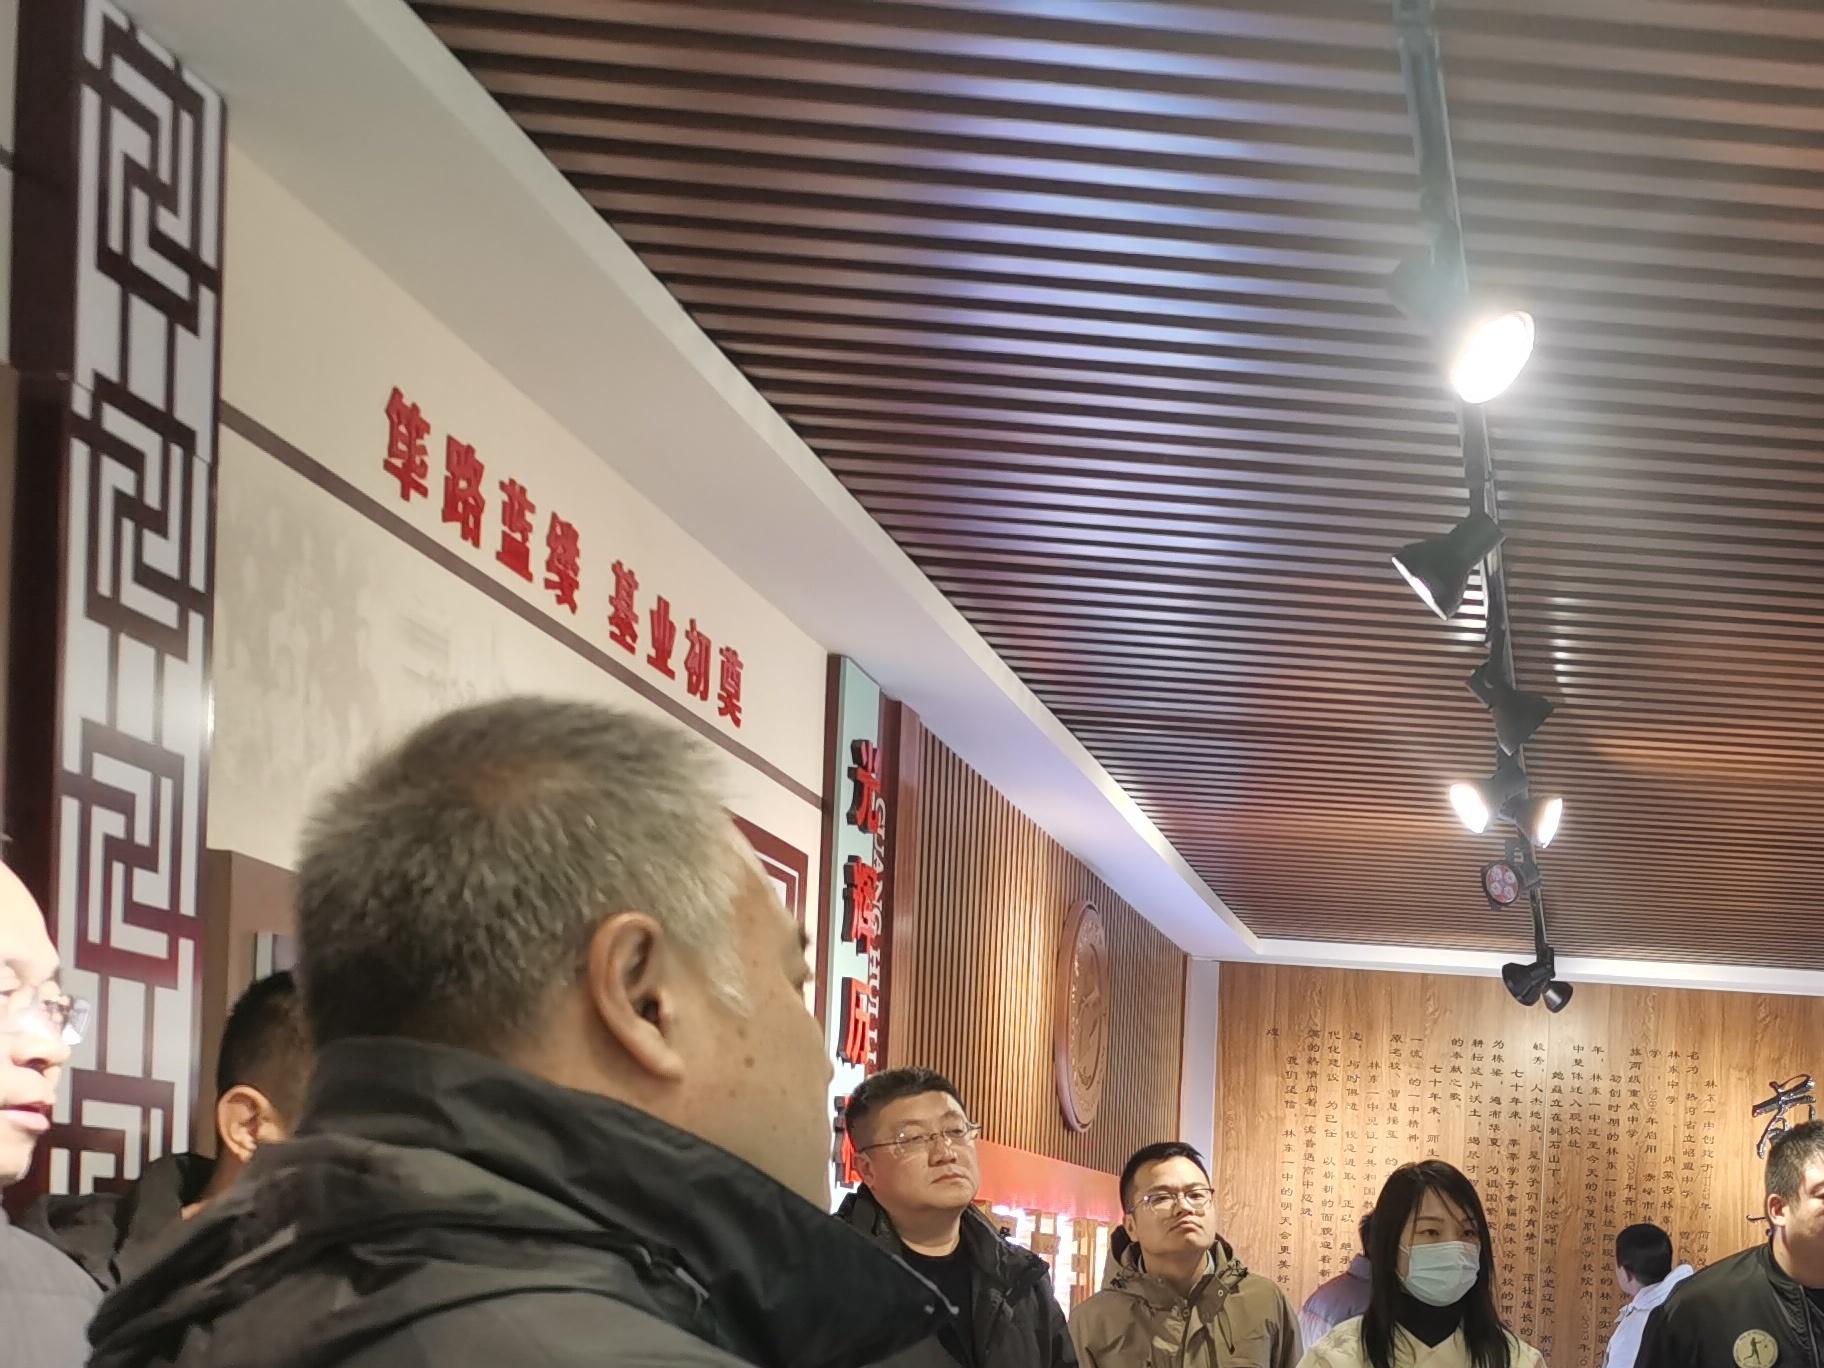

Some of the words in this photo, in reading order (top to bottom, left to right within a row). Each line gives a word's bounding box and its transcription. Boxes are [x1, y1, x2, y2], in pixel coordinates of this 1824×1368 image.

[608, 560, 744, 728] 基业初奠
[833, 739, 883, 1150] 光辉历
